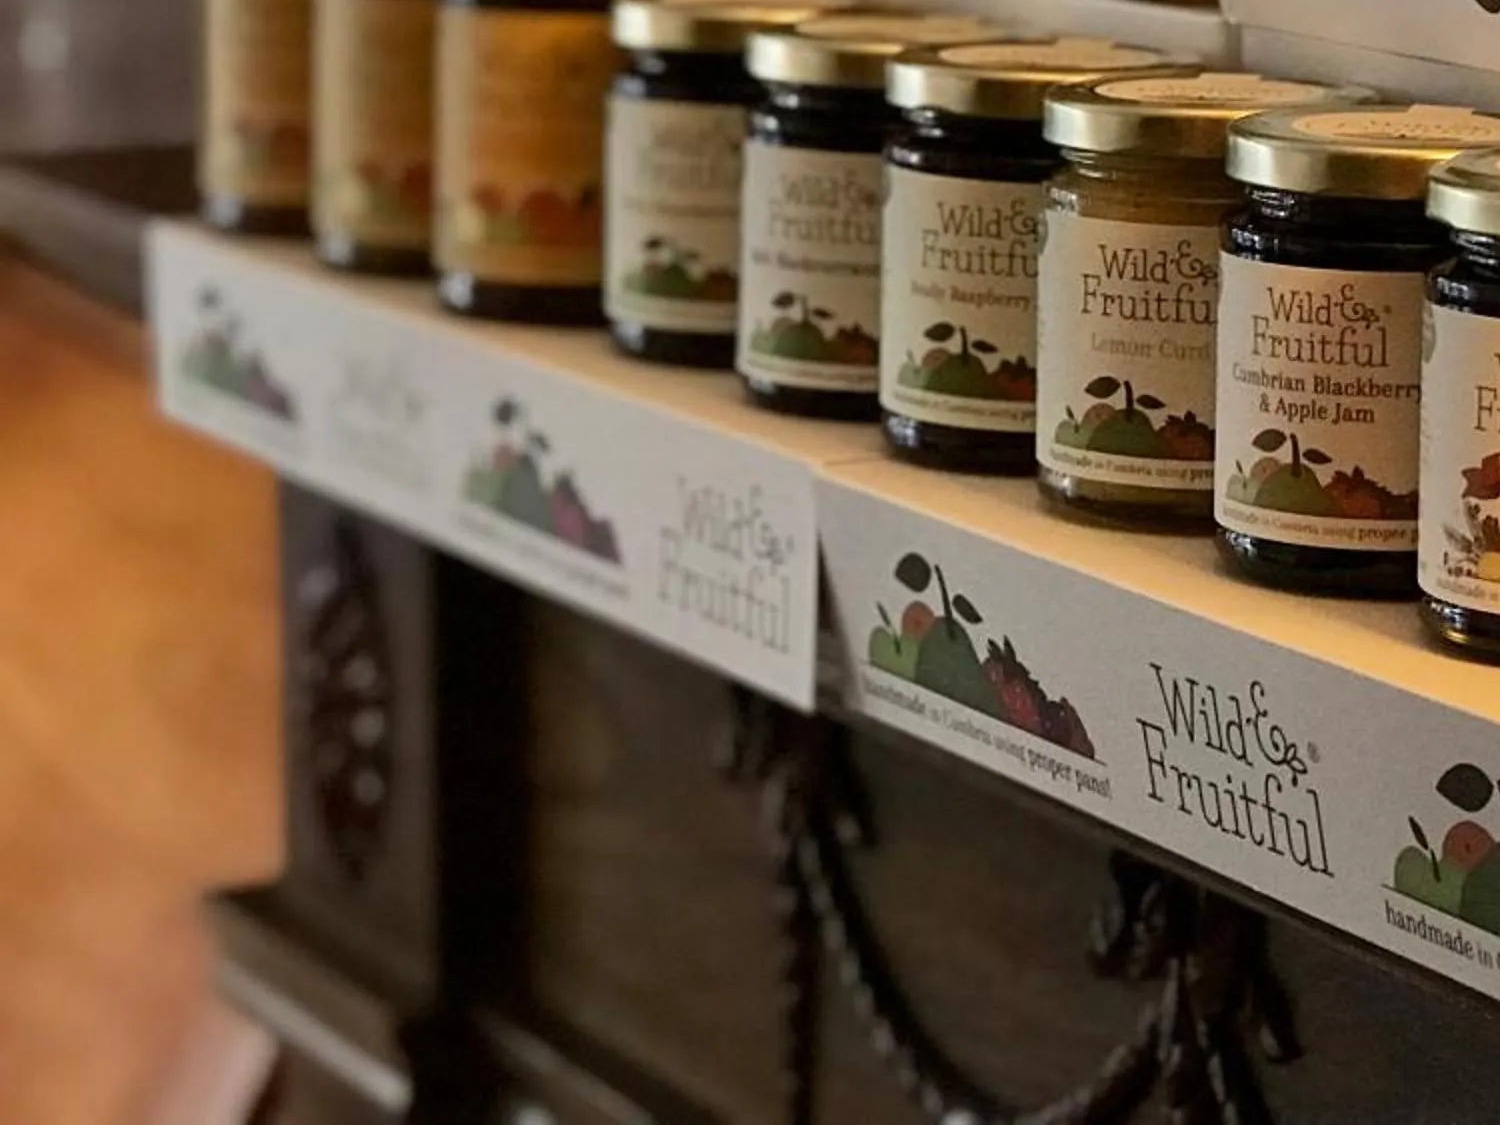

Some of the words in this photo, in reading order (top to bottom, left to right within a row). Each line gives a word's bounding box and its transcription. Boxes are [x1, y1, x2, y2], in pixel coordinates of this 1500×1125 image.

[937, 201, 1003, 240] Wild
[921, 228, 1039, 278] Fruitfu
[1098, 244, 1170, 284] Wild
[1170, 239, 1218, 286] &
[1081, 273, 1218, 326] Fruitfu
[1267, 287, 1334, 328] Wild
[1334, 283, 1380, 330] &
[1091, 332, 1152, 359] Lemon
[1252, 315, 1390, 368] Fruitful
[1233, 363, 1305, 392] Cumbrian
[1259, 393, 1270, 413] &
[1275, 397, 1328, 424] Apple
[1332, 402, 1375, 425] Jam
[677, 474, 744, 565] Wild
[1359, 527, 1406, 541] proper
[656, 526, 791, 654] Fruitful
[1148, 662, 1254, 767] Wild
[1245, 680, 1308, 787] &
[1028, 748, 1072, 779] proper
[1075, 768, 1113, 801] pans!
[1136, 717, 1335, 878] Fruitful
[1384, 899, 1475, 962] handmade
[1477, 946, 1494, 969] in
